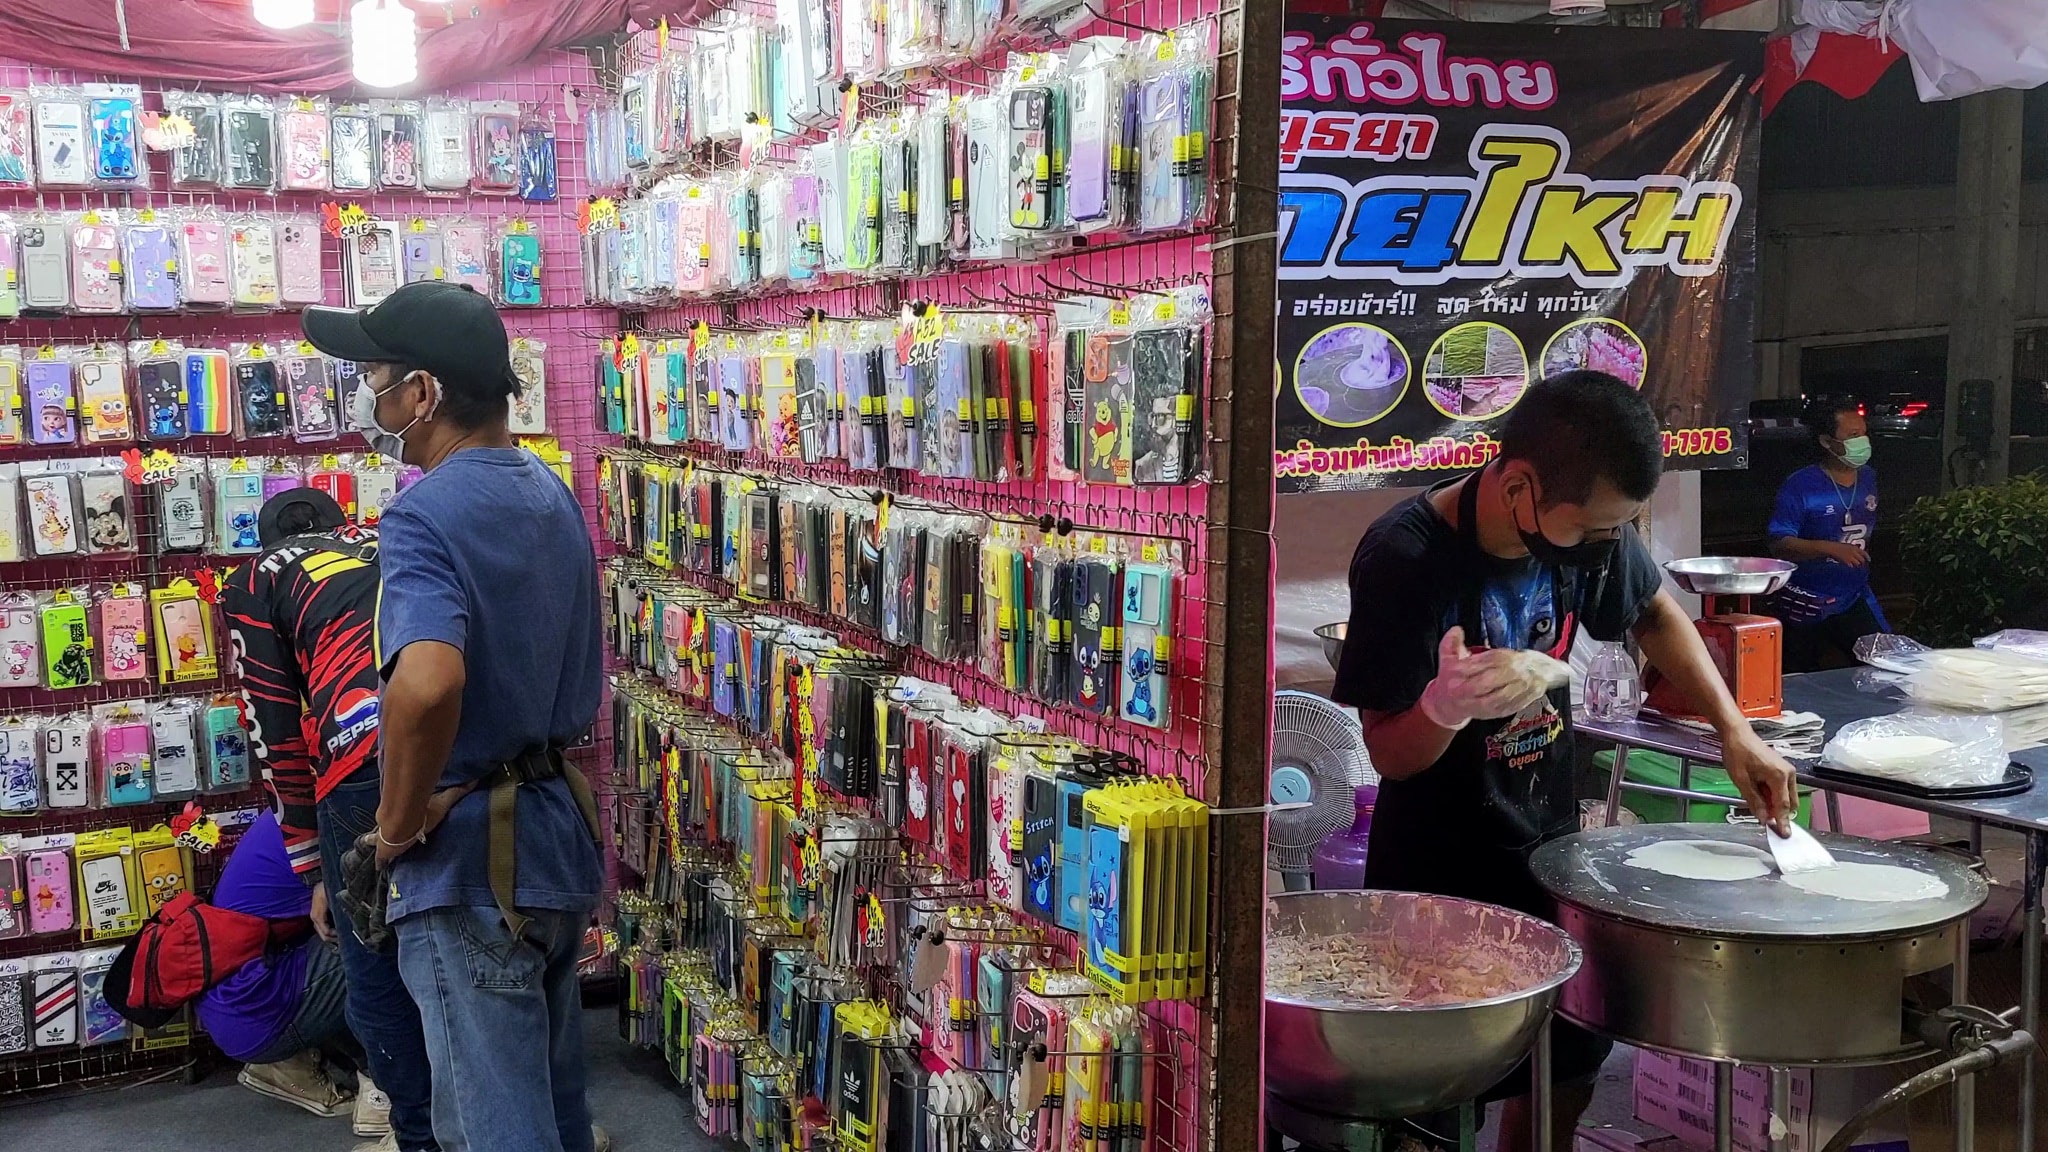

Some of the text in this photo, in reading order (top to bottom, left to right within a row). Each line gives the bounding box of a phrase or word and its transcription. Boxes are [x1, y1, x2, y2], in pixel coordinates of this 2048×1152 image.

[161, 134, 195, 150] SALE
[341, 223, 368, 238] SALE
[588, 217, 614, 235] SALE
[908, 338, 940, 364] SALE
[143, 467, 177, 484] SALE
[327, 716, 379, 754] PEPS
[1026, 816, 1055, 835] STITCH
[179, 832, 213, 854] SALE
[801, 862, 820, 886] SALE
[866, 928, 884, 948] SALE
[1111, 985, 1124, 998] CASE
[843, 1089, 860, 1104] adidas
